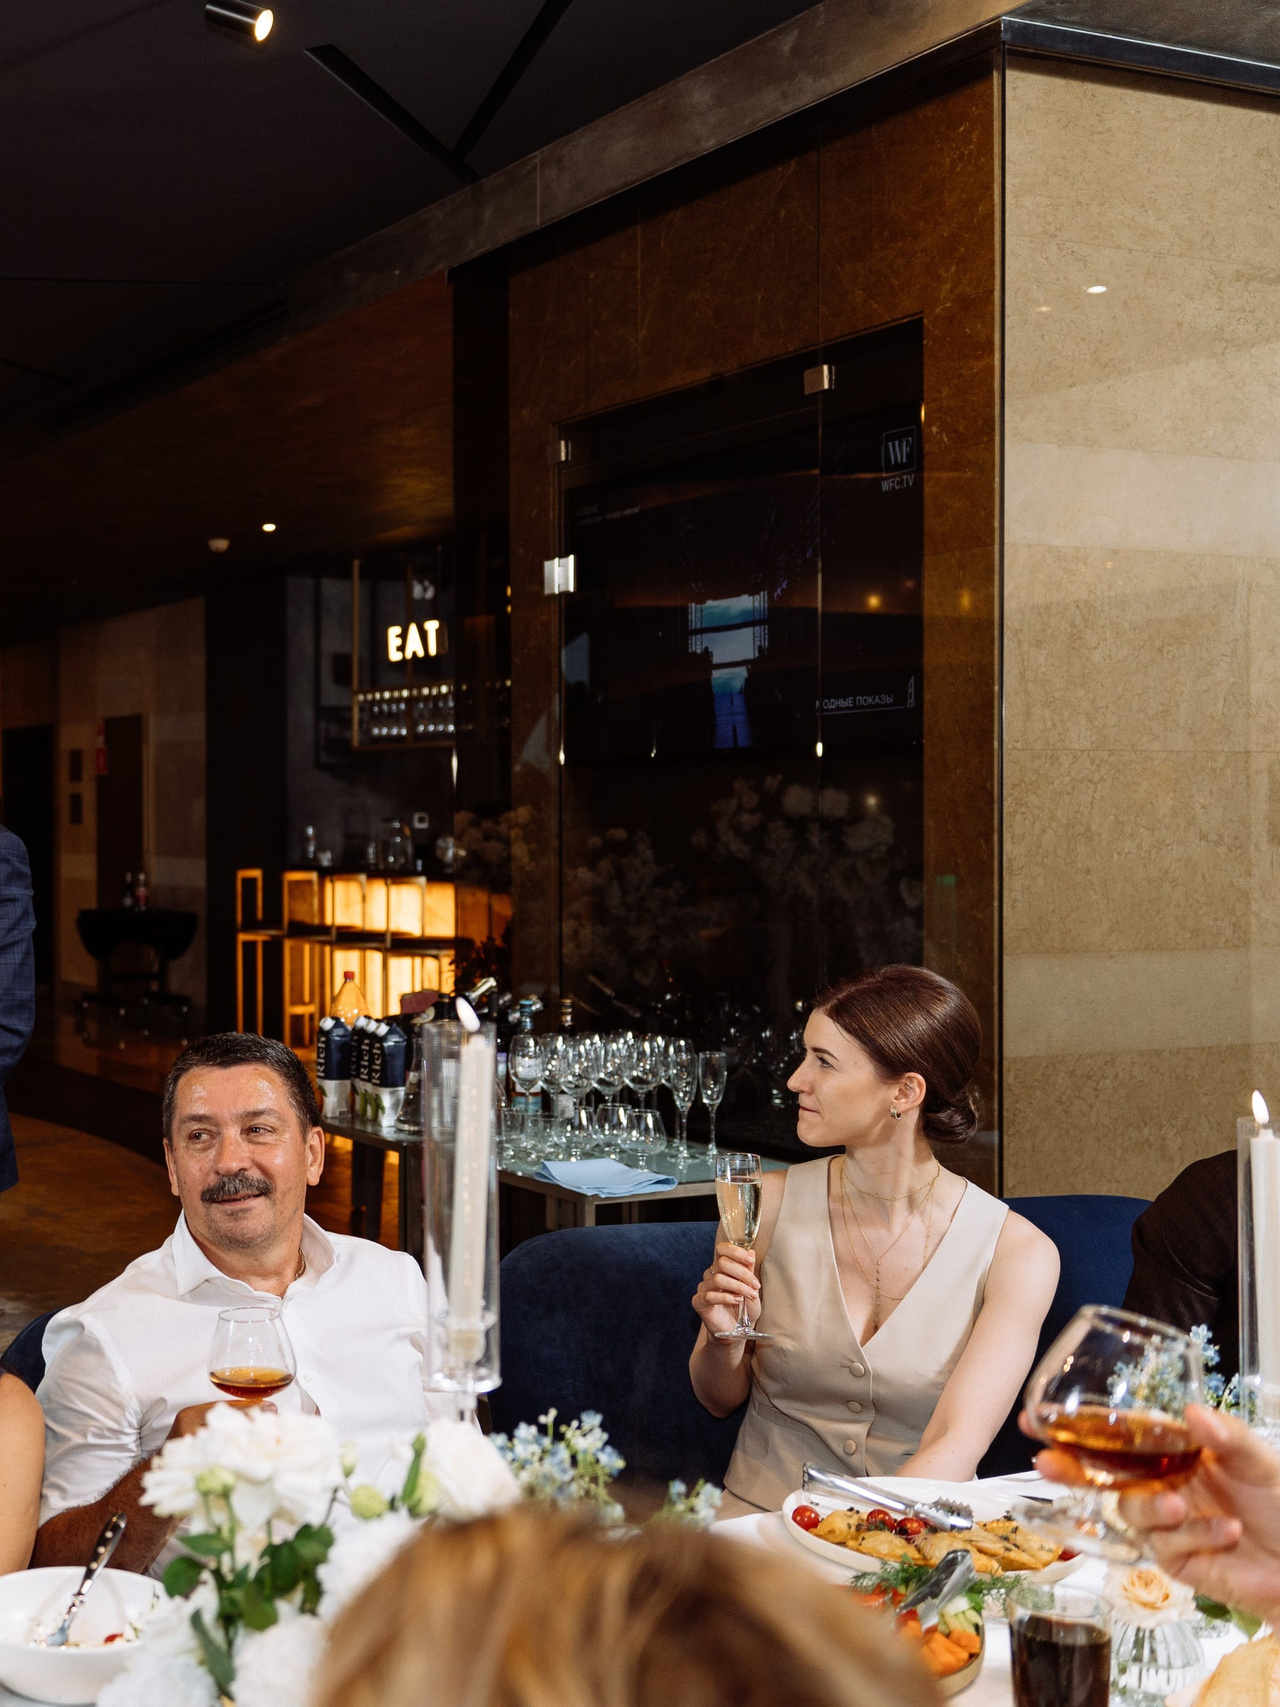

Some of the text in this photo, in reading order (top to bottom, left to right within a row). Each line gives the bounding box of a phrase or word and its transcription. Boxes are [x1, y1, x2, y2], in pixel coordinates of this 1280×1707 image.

[887, 437, 912, 466] WF
[881, 473, 915, 492] WFC.TV
[387, 619, 440, 662] EAT
[856, 693, 894, 706] ПОКАЗЫ
[317, 1036, 326, 1077] Rich
[360, 1039, 370, 1079] Rich
[371, 1042, 382, 1084] Rich
